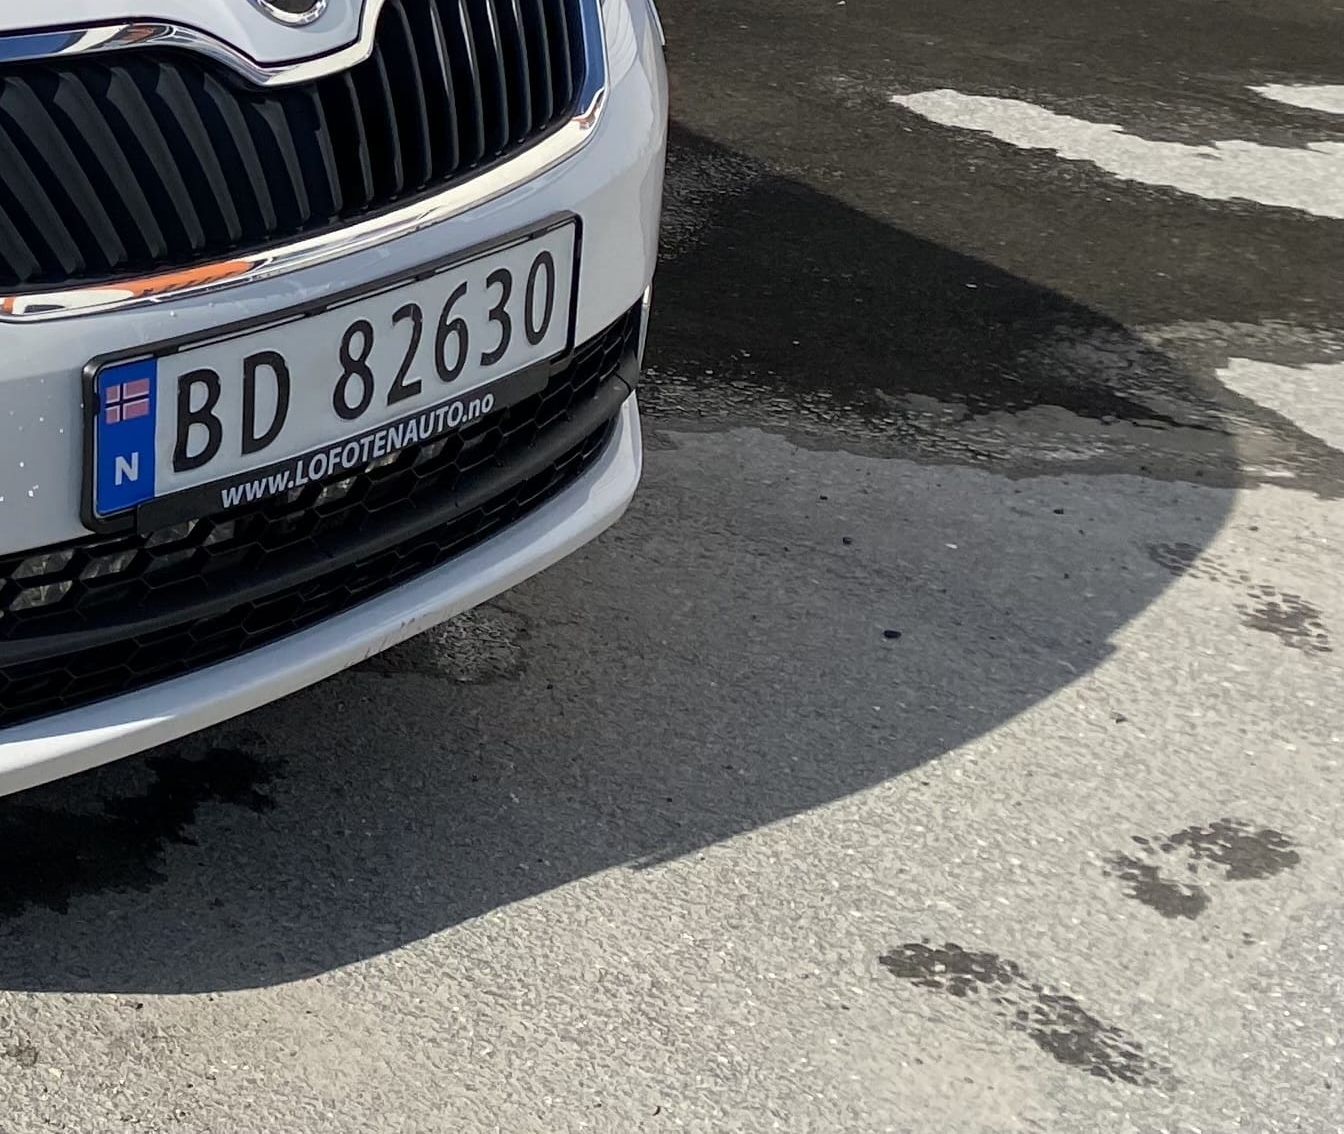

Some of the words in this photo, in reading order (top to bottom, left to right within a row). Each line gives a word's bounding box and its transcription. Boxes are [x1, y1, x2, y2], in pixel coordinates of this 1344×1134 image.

[172, 350, 291, 474] BD
[332, 250, 555, 421] 82630
[114, 452, 139, 486] N
[221, 391, 496, 509] www.LOFOTENAUTO.no
